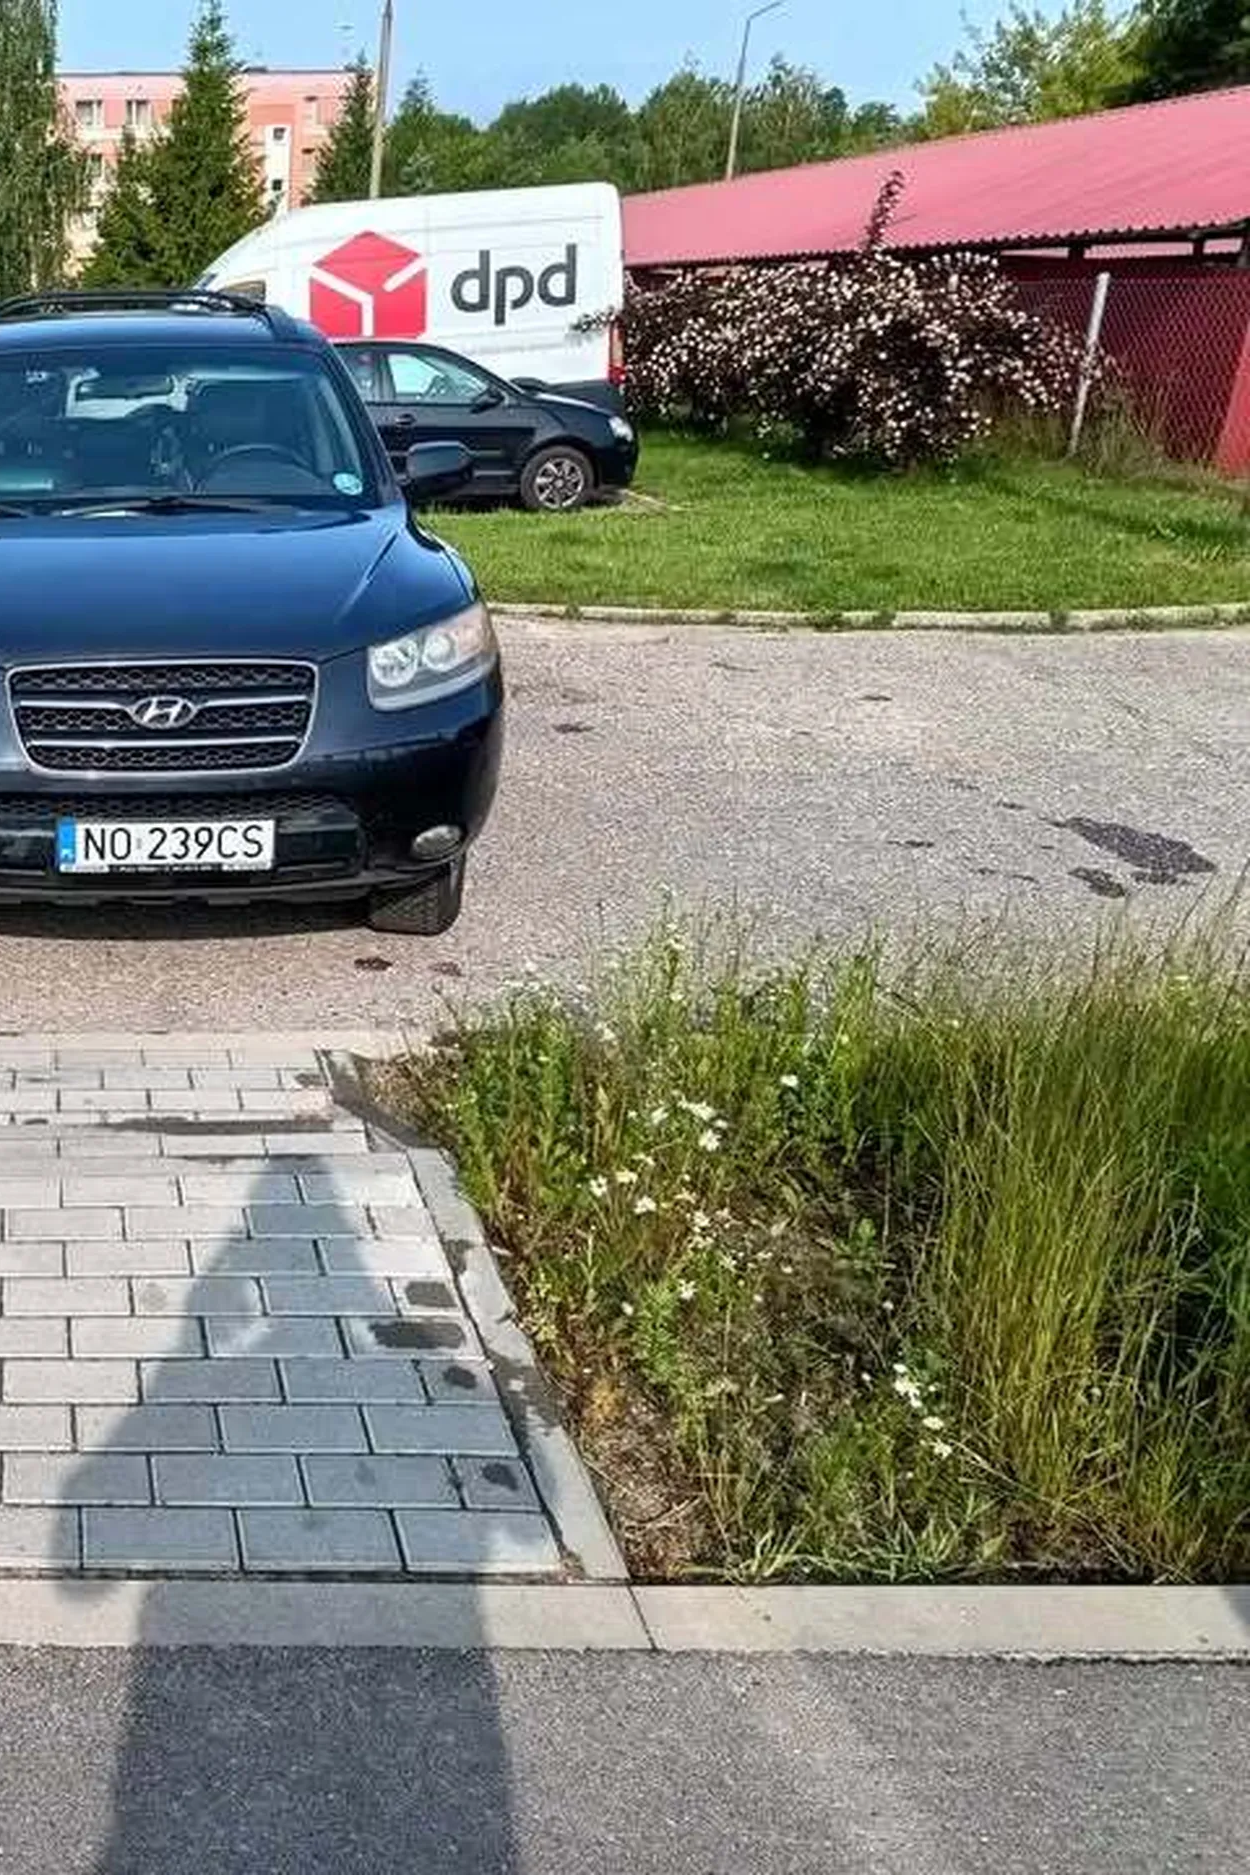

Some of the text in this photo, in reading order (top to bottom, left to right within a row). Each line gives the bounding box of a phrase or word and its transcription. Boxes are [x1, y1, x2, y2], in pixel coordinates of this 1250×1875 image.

[450, 243, 577, 327] dpd
[84, 827, 132, 860] NO
[148, 825, 264, 860] 239CS
